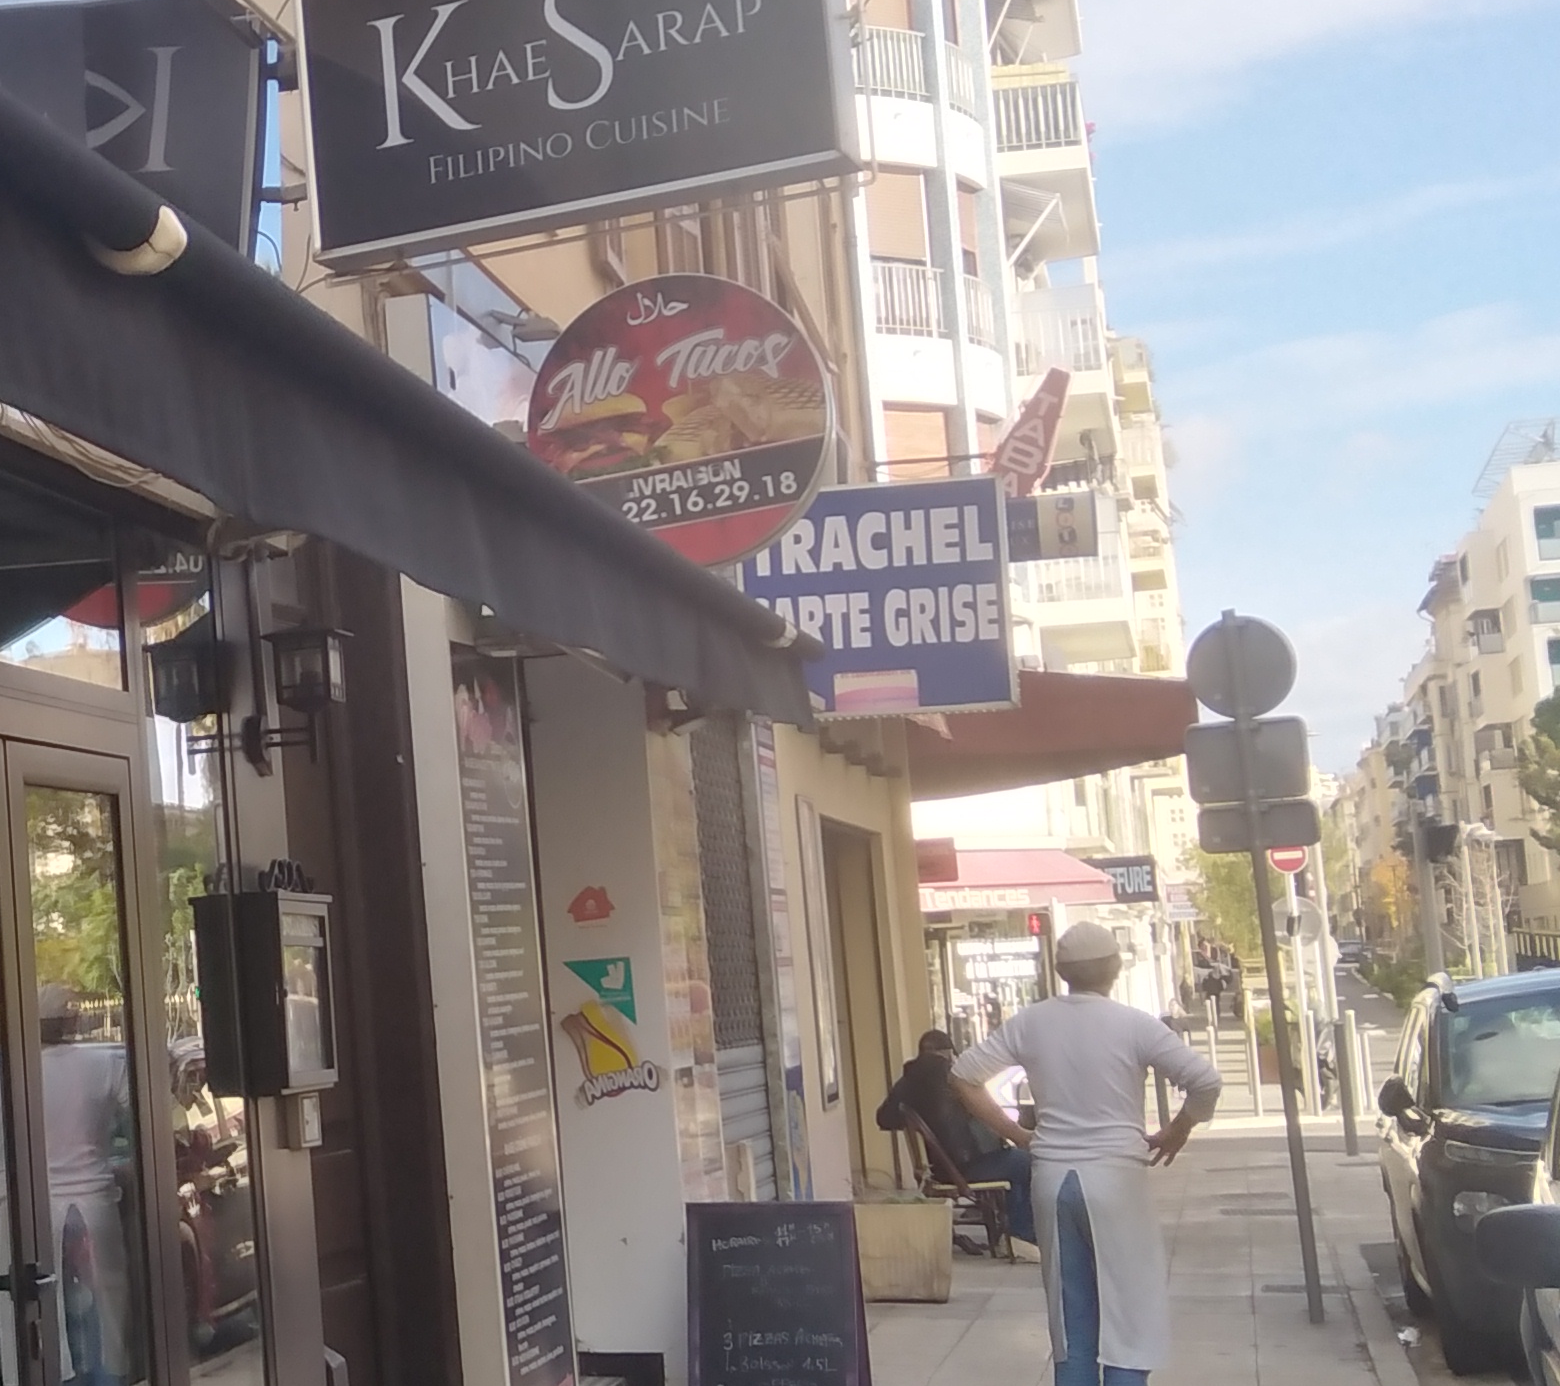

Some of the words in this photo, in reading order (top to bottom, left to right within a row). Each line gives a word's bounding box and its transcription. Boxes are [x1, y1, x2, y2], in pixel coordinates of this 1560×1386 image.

[427, 132, 573, 184] FILIPINO
[584, 97, 731, 150] CUISINE
[626, 292, 690, 326] حلال
[539, 347, 638, 432] Allo
[656, 327, 794, 389] Tacos
[627, 458, 742, 499] IVRAISON
[754, 591, 872, 650] ARTE
[884, 582, 1000, 647] GRISE
